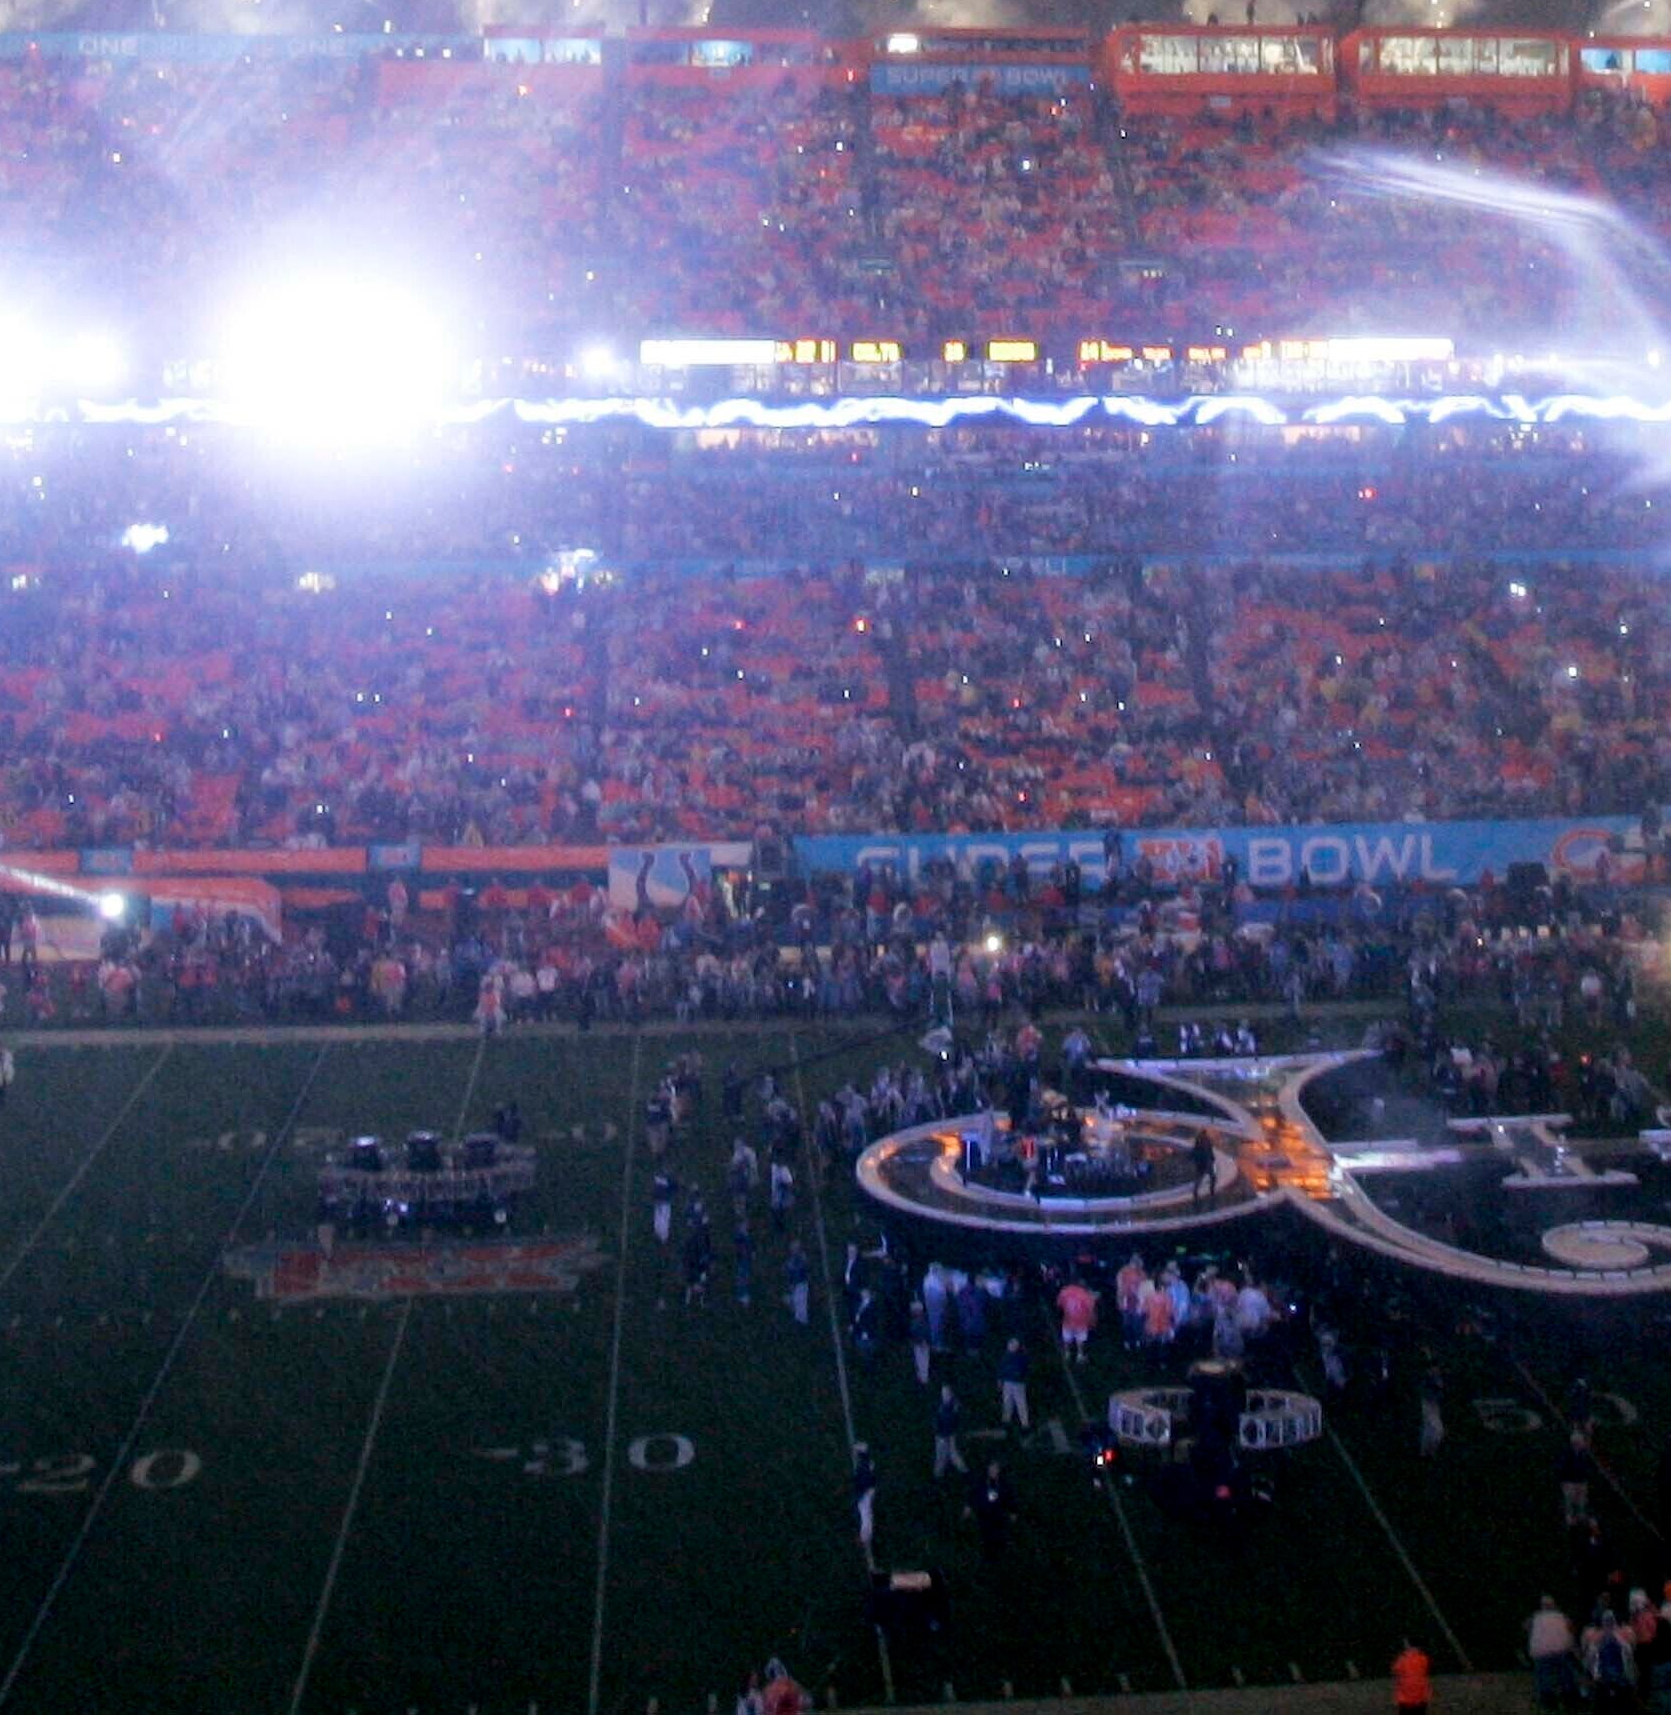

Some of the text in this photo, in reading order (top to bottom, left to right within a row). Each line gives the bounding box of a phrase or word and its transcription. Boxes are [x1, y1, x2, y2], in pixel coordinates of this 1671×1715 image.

[1247, 833, 1459, 886] BOWL
[14, 1449, 204, 1493] 20
[522, 1431, 697, 1477] 30
